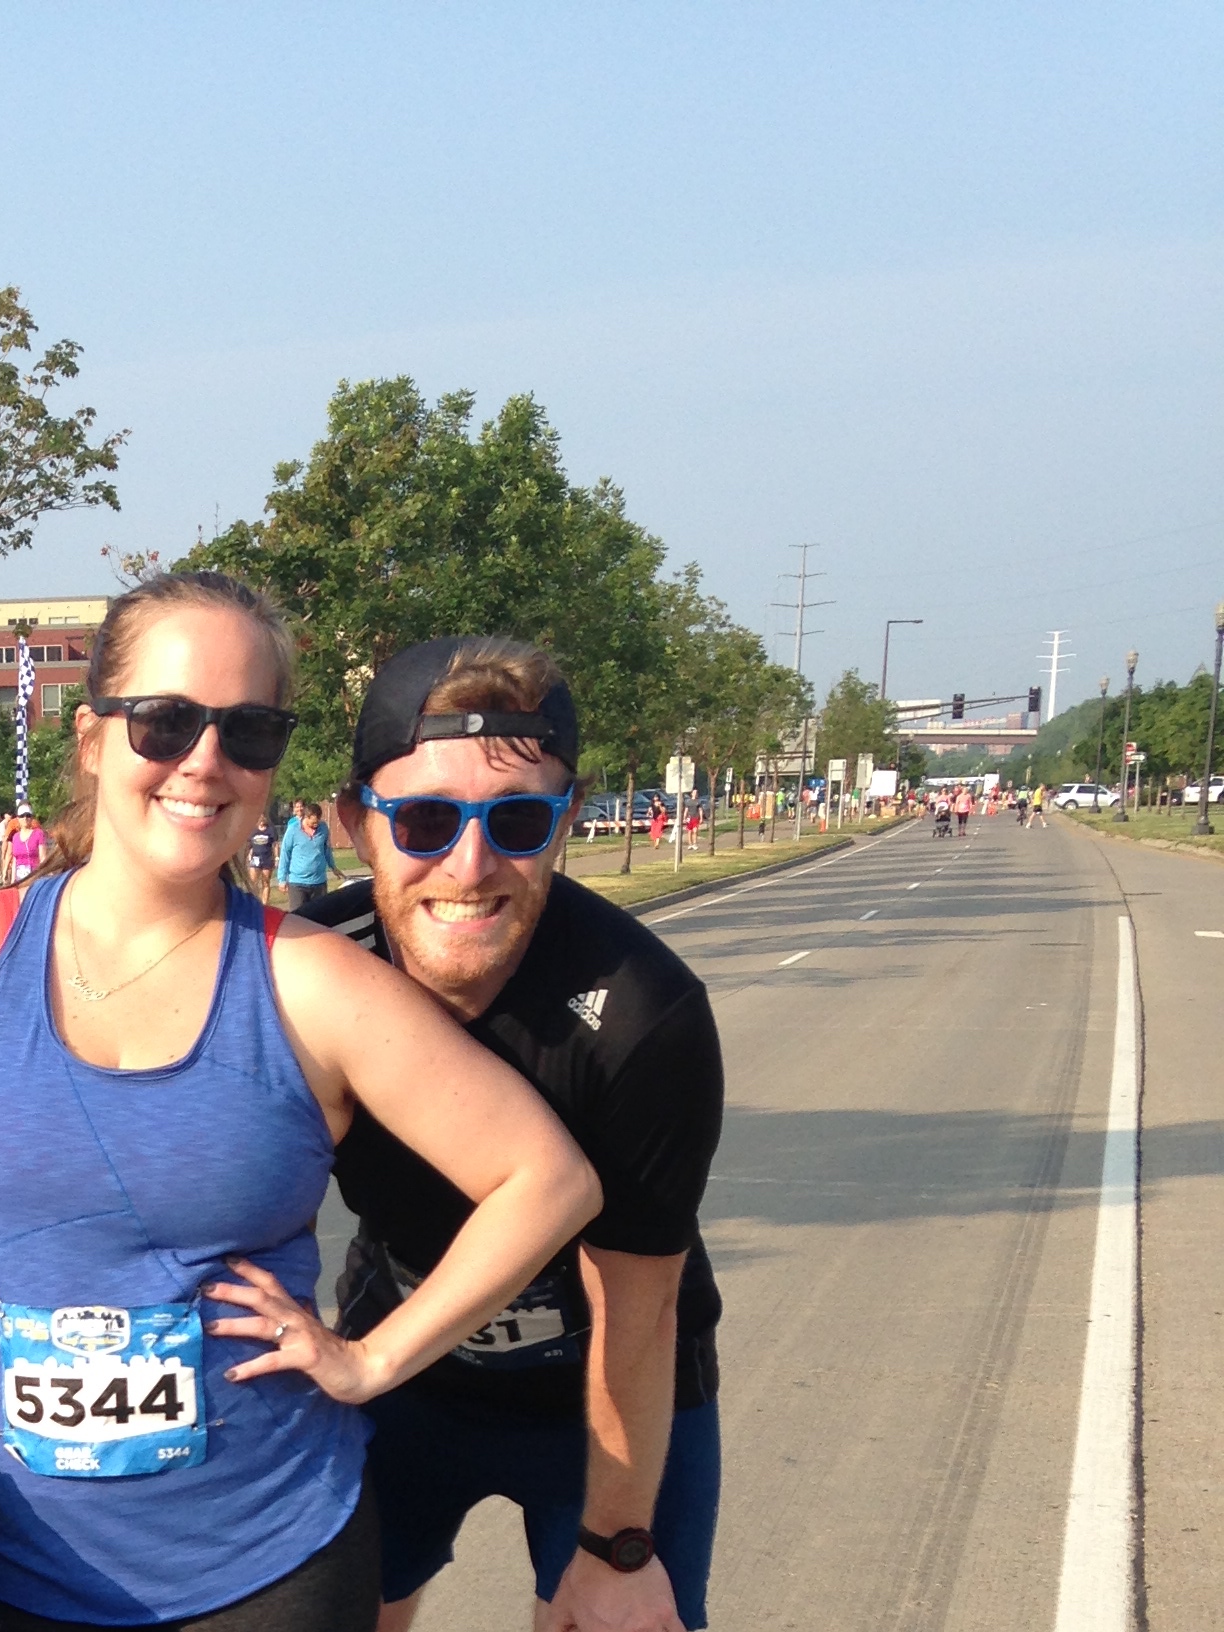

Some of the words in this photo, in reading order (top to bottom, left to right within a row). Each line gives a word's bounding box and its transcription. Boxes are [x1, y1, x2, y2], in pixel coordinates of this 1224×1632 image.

[567, 997, 602, 1031] adidas
[14, 1373, 185, 1428] 5344
[55, 1458, 101, 1471] CHECK
[157, 1447, 191, 1460] 5344
